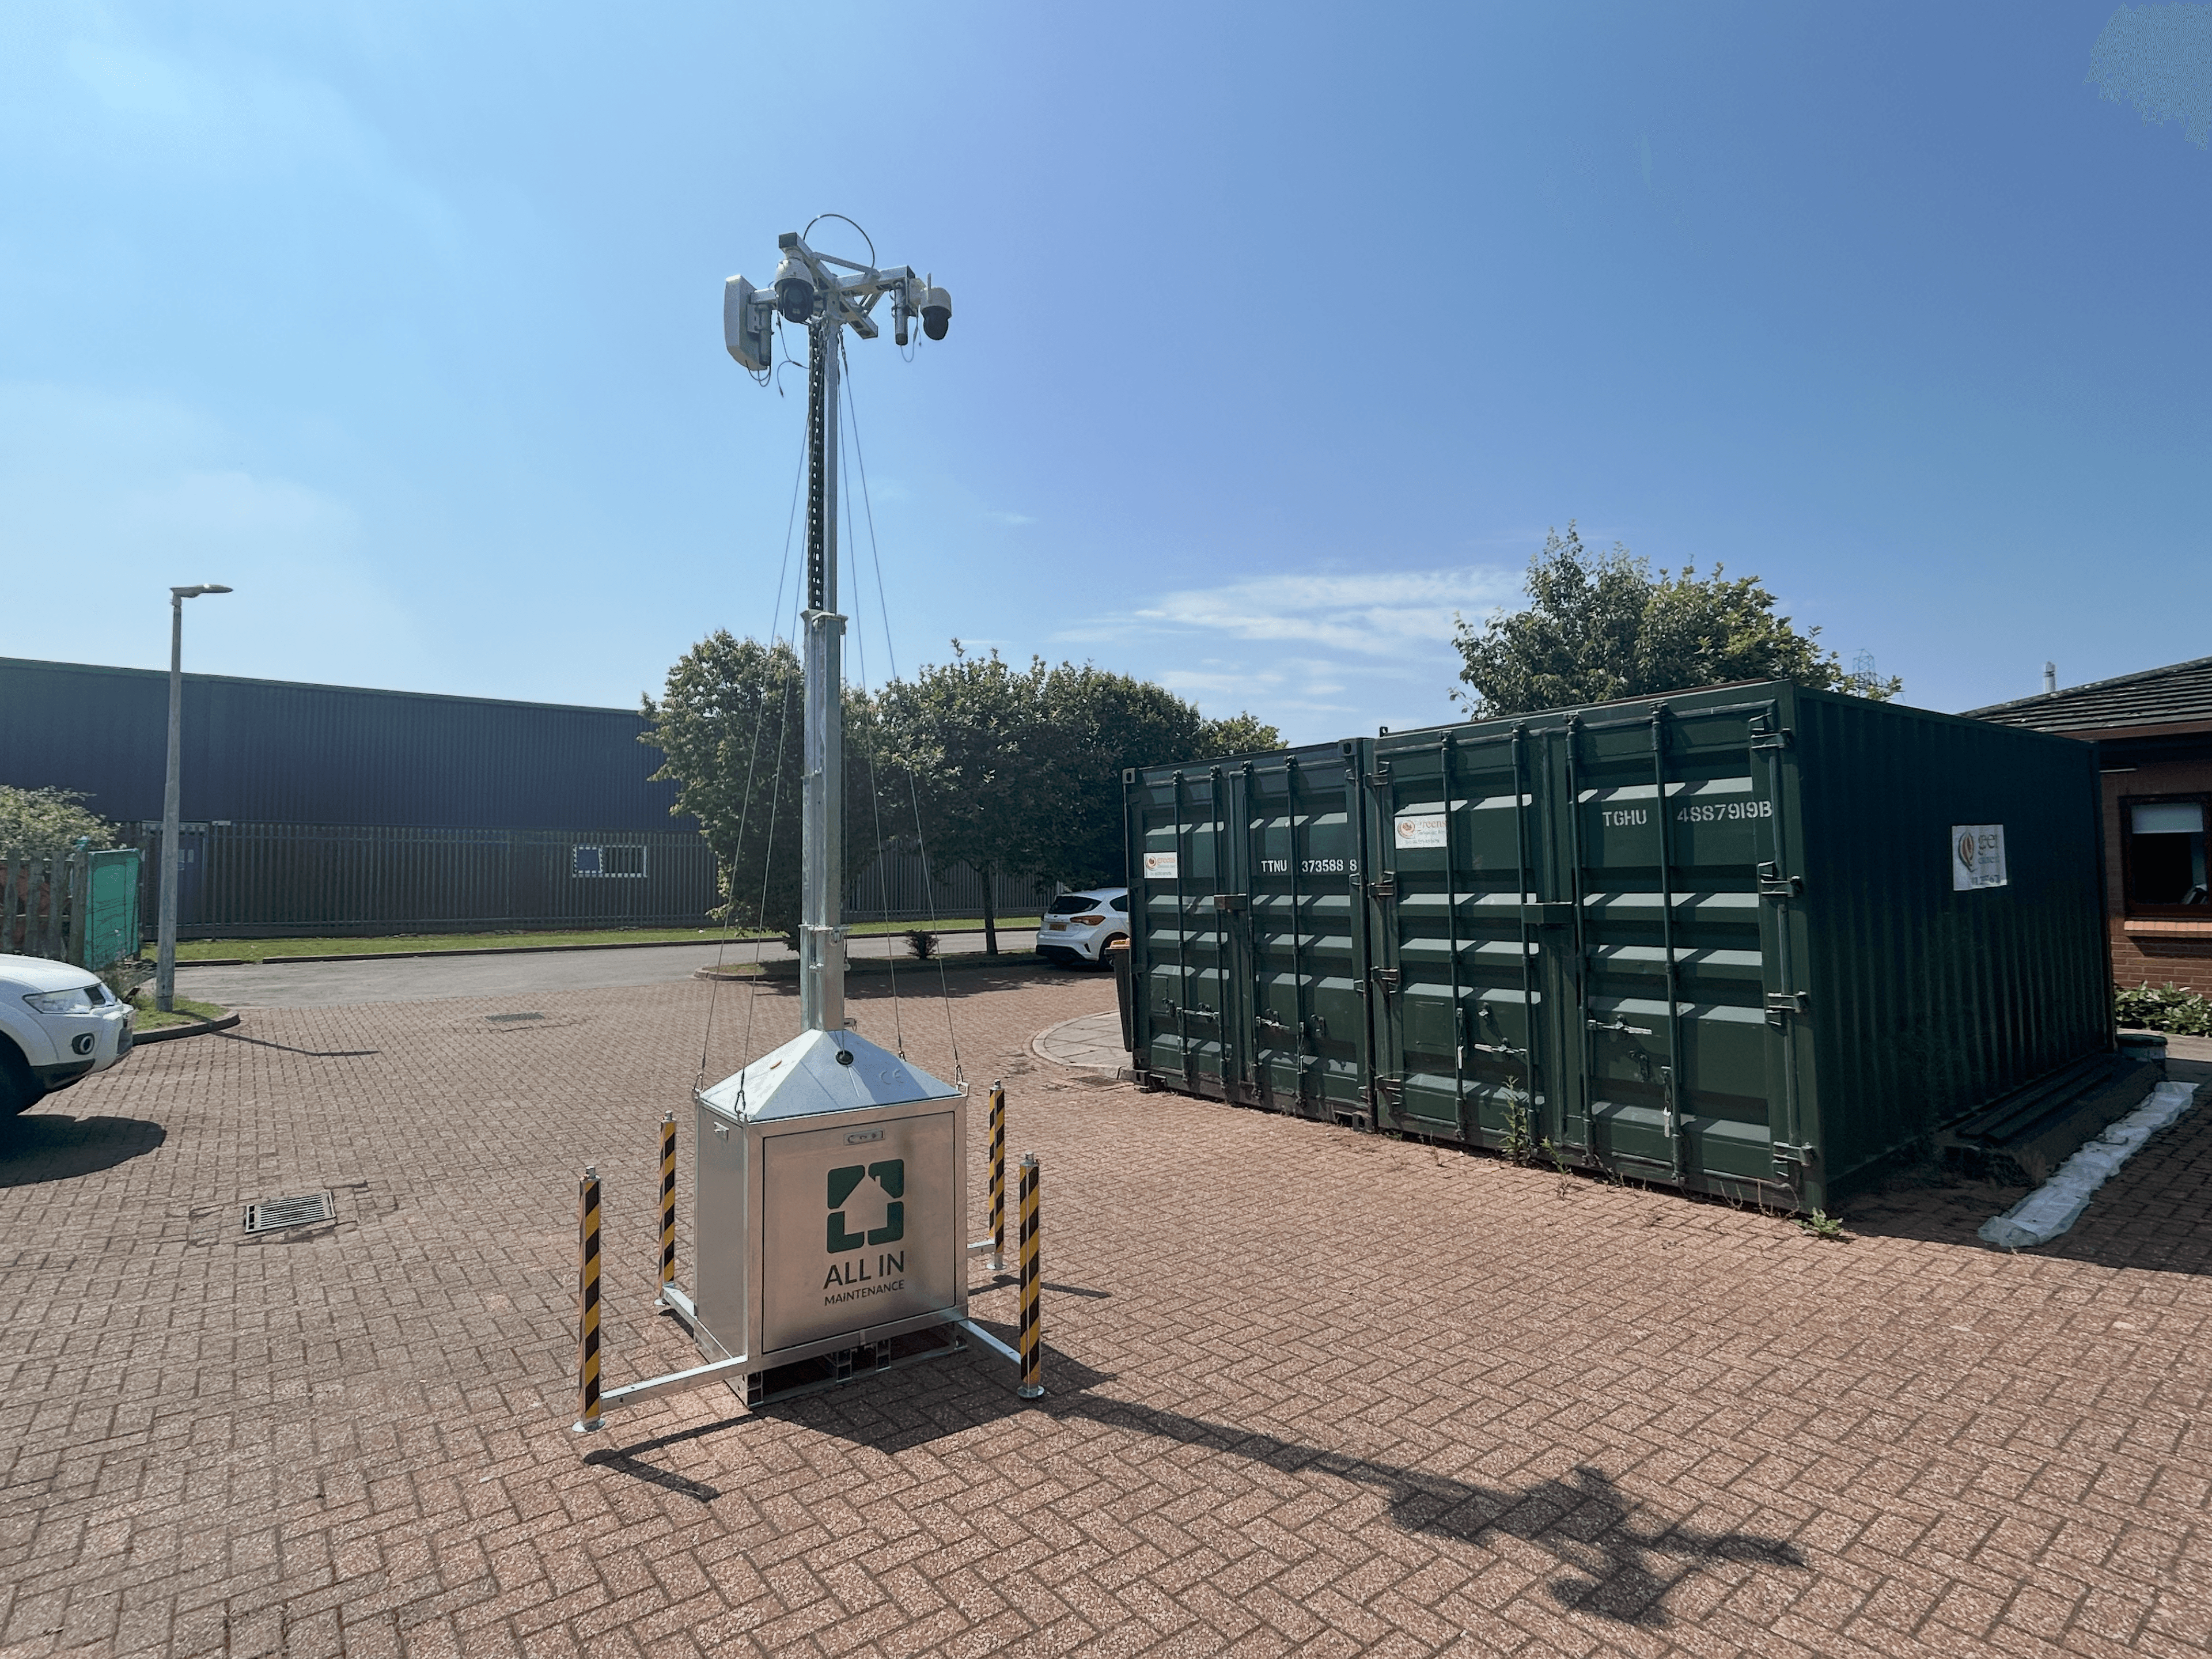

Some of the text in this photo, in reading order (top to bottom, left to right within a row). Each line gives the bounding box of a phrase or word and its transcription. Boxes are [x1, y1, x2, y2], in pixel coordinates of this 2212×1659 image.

[1602, 809, 1647, 827] TGHU
[1261, 859, 1357, 873] TTNU 373588 8
[823, 1250, 904, 1290] ALL IN
[824, 1279, 904, 1306] MAINTENANCE
